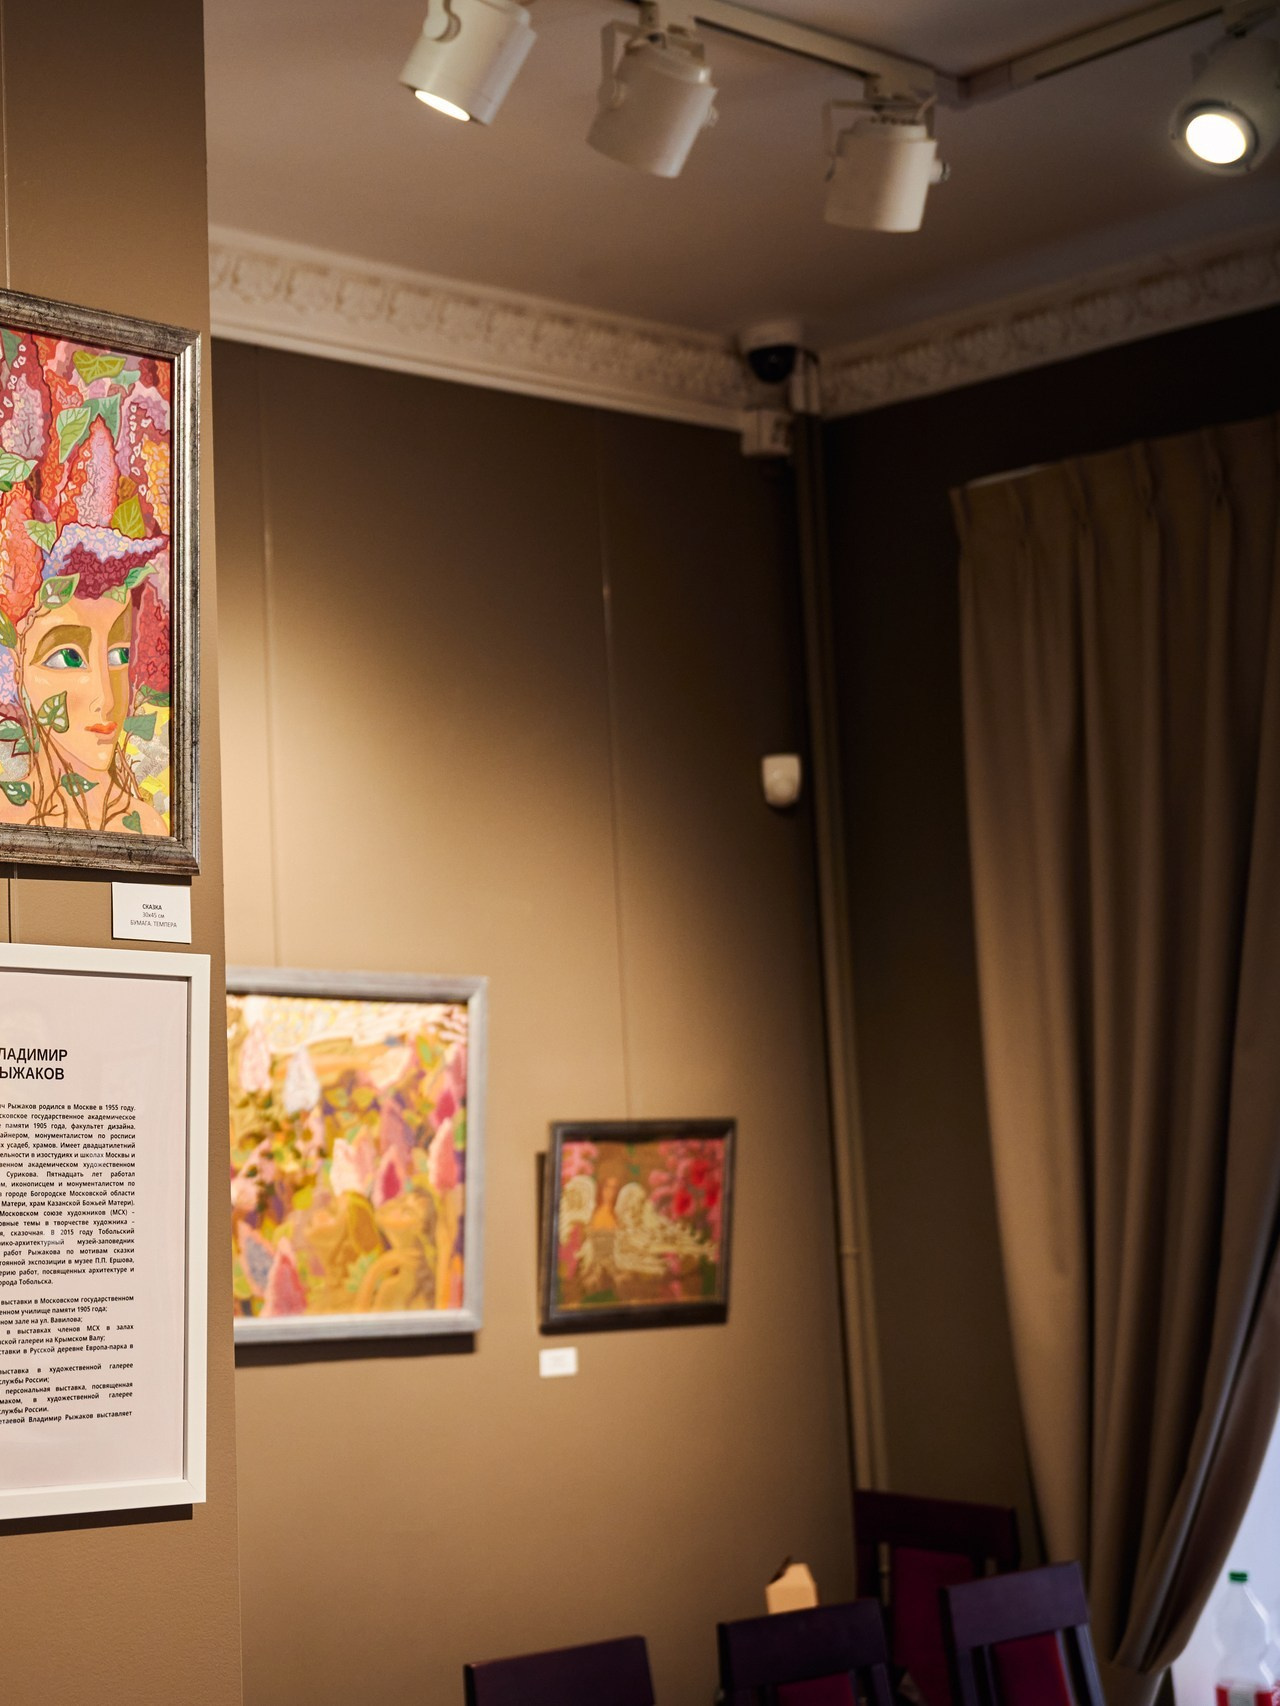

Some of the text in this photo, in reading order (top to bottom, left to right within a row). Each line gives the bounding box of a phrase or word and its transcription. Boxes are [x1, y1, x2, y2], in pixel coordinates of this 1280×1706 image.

[70, 1123, 104, 1131] факультет
[107, 1124, 136, 1132] дизайна.
[34, 1133, 93, 1141] монументалистом
[6, 1142, 30, 1150] усадеб,
[82, 1142, 136, 1150] двадцатилетний
[6, 1171, 39, 1179] Сурикова.
[46, 1171, 84, 1179] Пятнадцать
[110, 1171, 135, 1179] работал
[30, 1190, 66, 1198] Богородске
[1, 1200, 28, 1208] Матери,
[108, 1200, 135, 1208] Матери).
[67, 1210, 106, 1218] художников
[110, 1209, 128, 1217] (МСХ)
[77, 1238, 135, 1246] музей-заповедник
[3, 1249, 22, 1258] работ
[28, 1259, 66, 1267] экспозиции
[109, 1257, 135, 1265] Ершова,
[19, 1269, 39, 1277] работ,
[19, 1278, 53, 1286] Тобольска.
[40, 1297, 79, 1305] Московском
[80, 1296, 134, 1304] государственном
[50, 1316, 83, 1325] Вавилова;
[18, 1335, 105, 1346] галереи Крымском Валу;
[57, 1346, 84, 1354] деревне
[109, 1363, 133, 1371] галерее
[25, 1376, 50, 1385] России;
[5, 1385, 87, 1396] персональная выставка,
[109, 1392, 133, 1400] галерее
[24, 1405, 49, 1414] России.
[28, 1411, 132, 1424] Владимир Рыжаков выставляет
